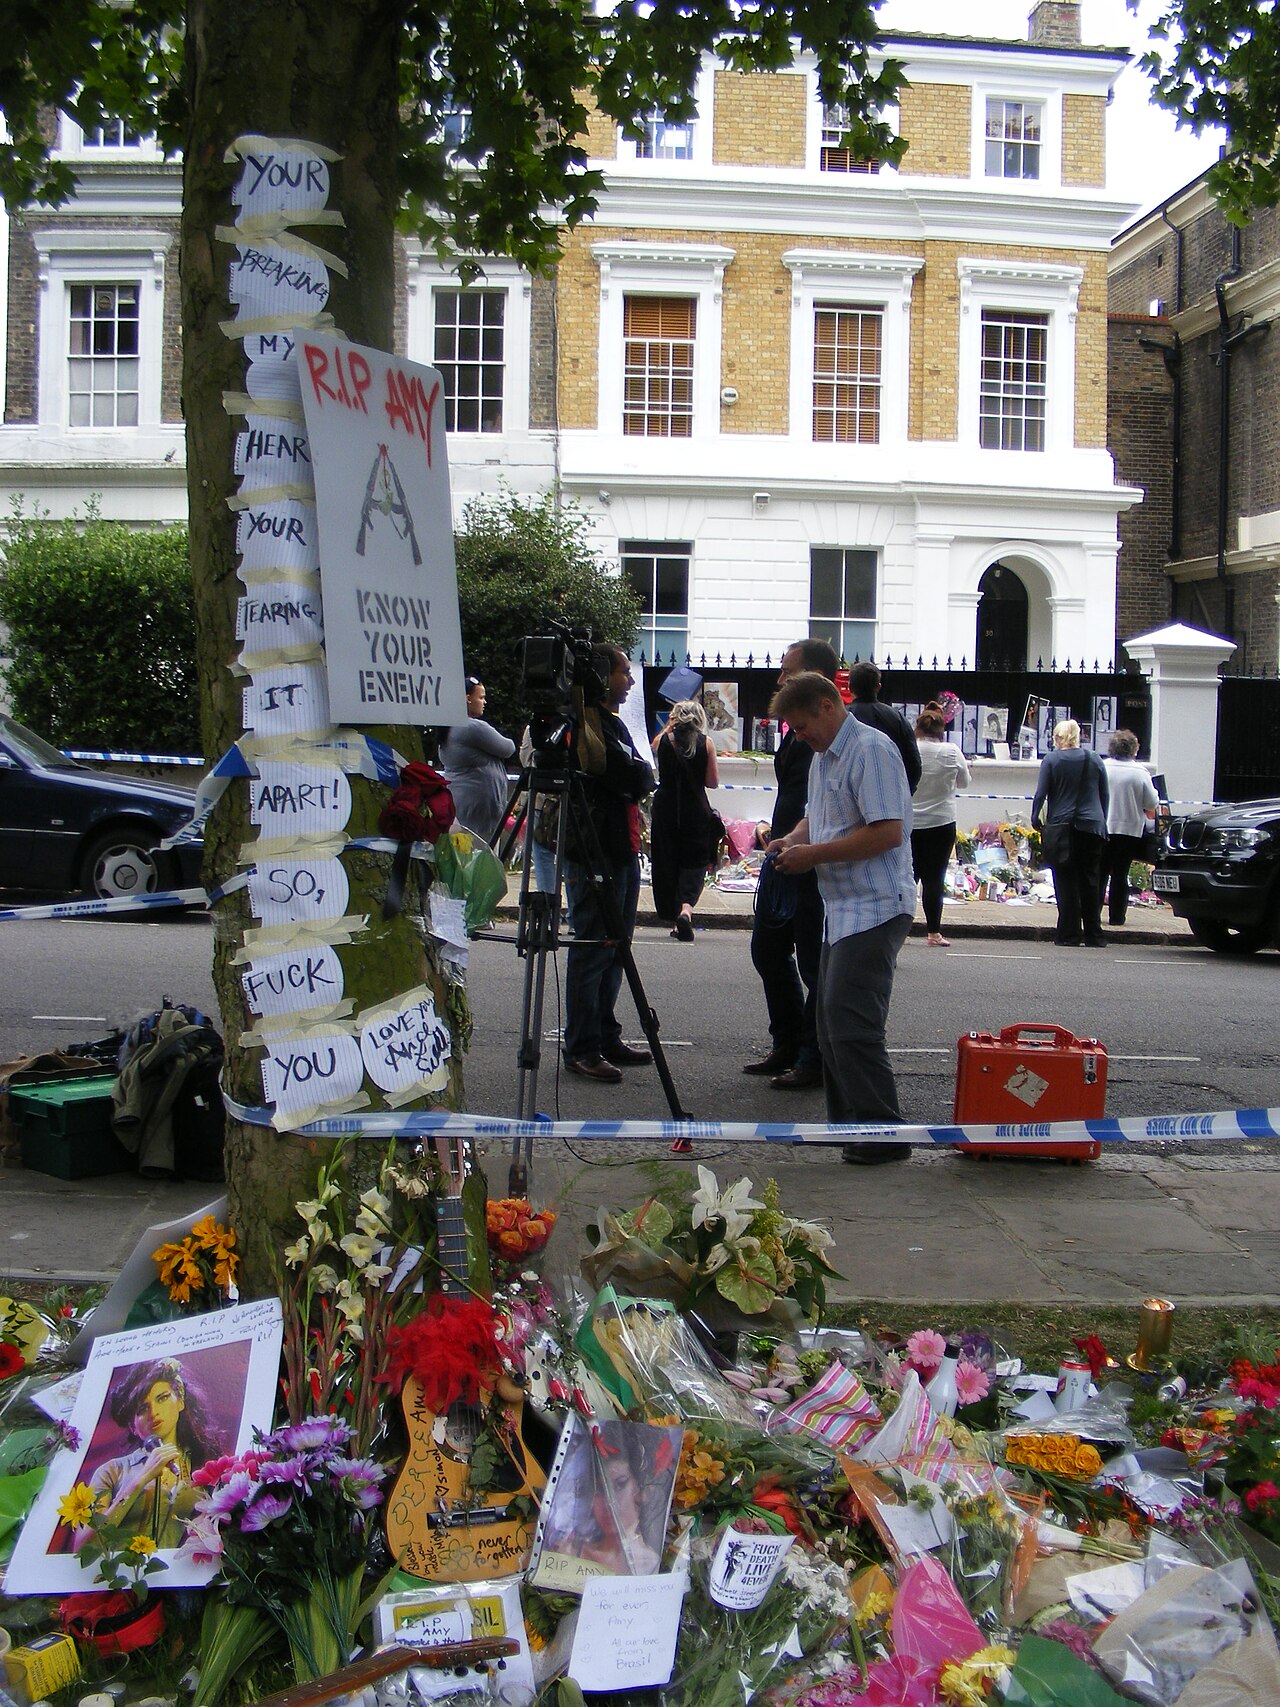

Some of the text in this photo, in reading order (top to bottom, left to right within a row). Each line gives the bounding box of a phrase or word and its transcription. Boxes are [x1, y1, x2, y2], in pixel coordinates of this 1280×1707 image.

[247, 154, 325, 195] YOUR
[238, 248, 330, 303] BREAKING
[259, 335, 295, 362] MY
[385, 367, 440, 470] AMY
[245, 429, 311, 464] HEAR
[247, 511, 307, 547] YOUR
[241, 602, 317, 631] TEARING
[355, 588, 431, 631] KNOW
[363, 630, 433, 669] YOUR
[359, 669, 443, 706] ENEMY
[257, 778, 340, 813] APART!
[268, 868, 326, 905] SO,
[248, 957, 335, 1003] FUCK
[368, 1010, 416, 1050] LOVE
[274, 1047, 336, 1091] YOU
[1146, 1115, 1216, 1136] DO NOT CROSS
[473, 1543, 524, 1569] forgotten
[478, 1534, 512, 1551] never
[749, 1555, 778, 1564] DEATH
[544, 1556, 569, 1571] RIP
[590, 1588, 606, 1597] We
[635, 1584, 656, 1593] miss
[659, 1583, 674, 1594] you
[422, 1627, 451, 1637] AMY
[608, 1615, 634, 1630] Amy
[642, 1637, 659, 1645] love
[616, 1653, 651, 1670] Brasil
